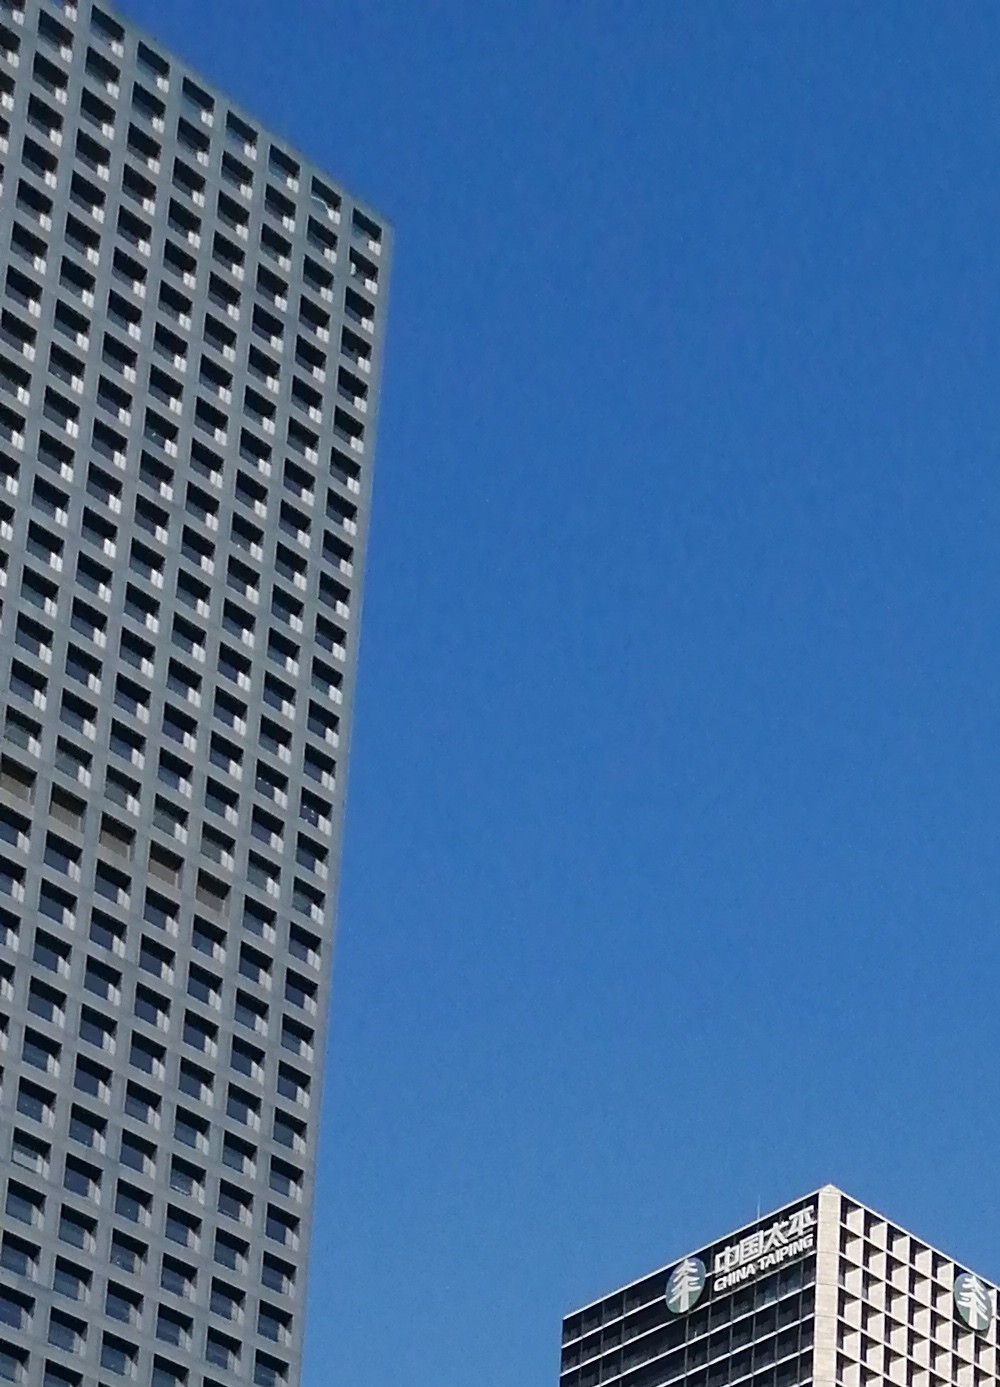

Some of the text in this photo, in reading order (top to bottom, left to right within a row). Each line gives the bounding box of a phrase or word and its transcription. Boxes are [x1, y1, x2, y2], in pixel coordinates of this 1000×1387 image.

[714, 1234, 814, 1291] CHINA TAIPING
[715, 1205, 817, 1273] 中国太平
